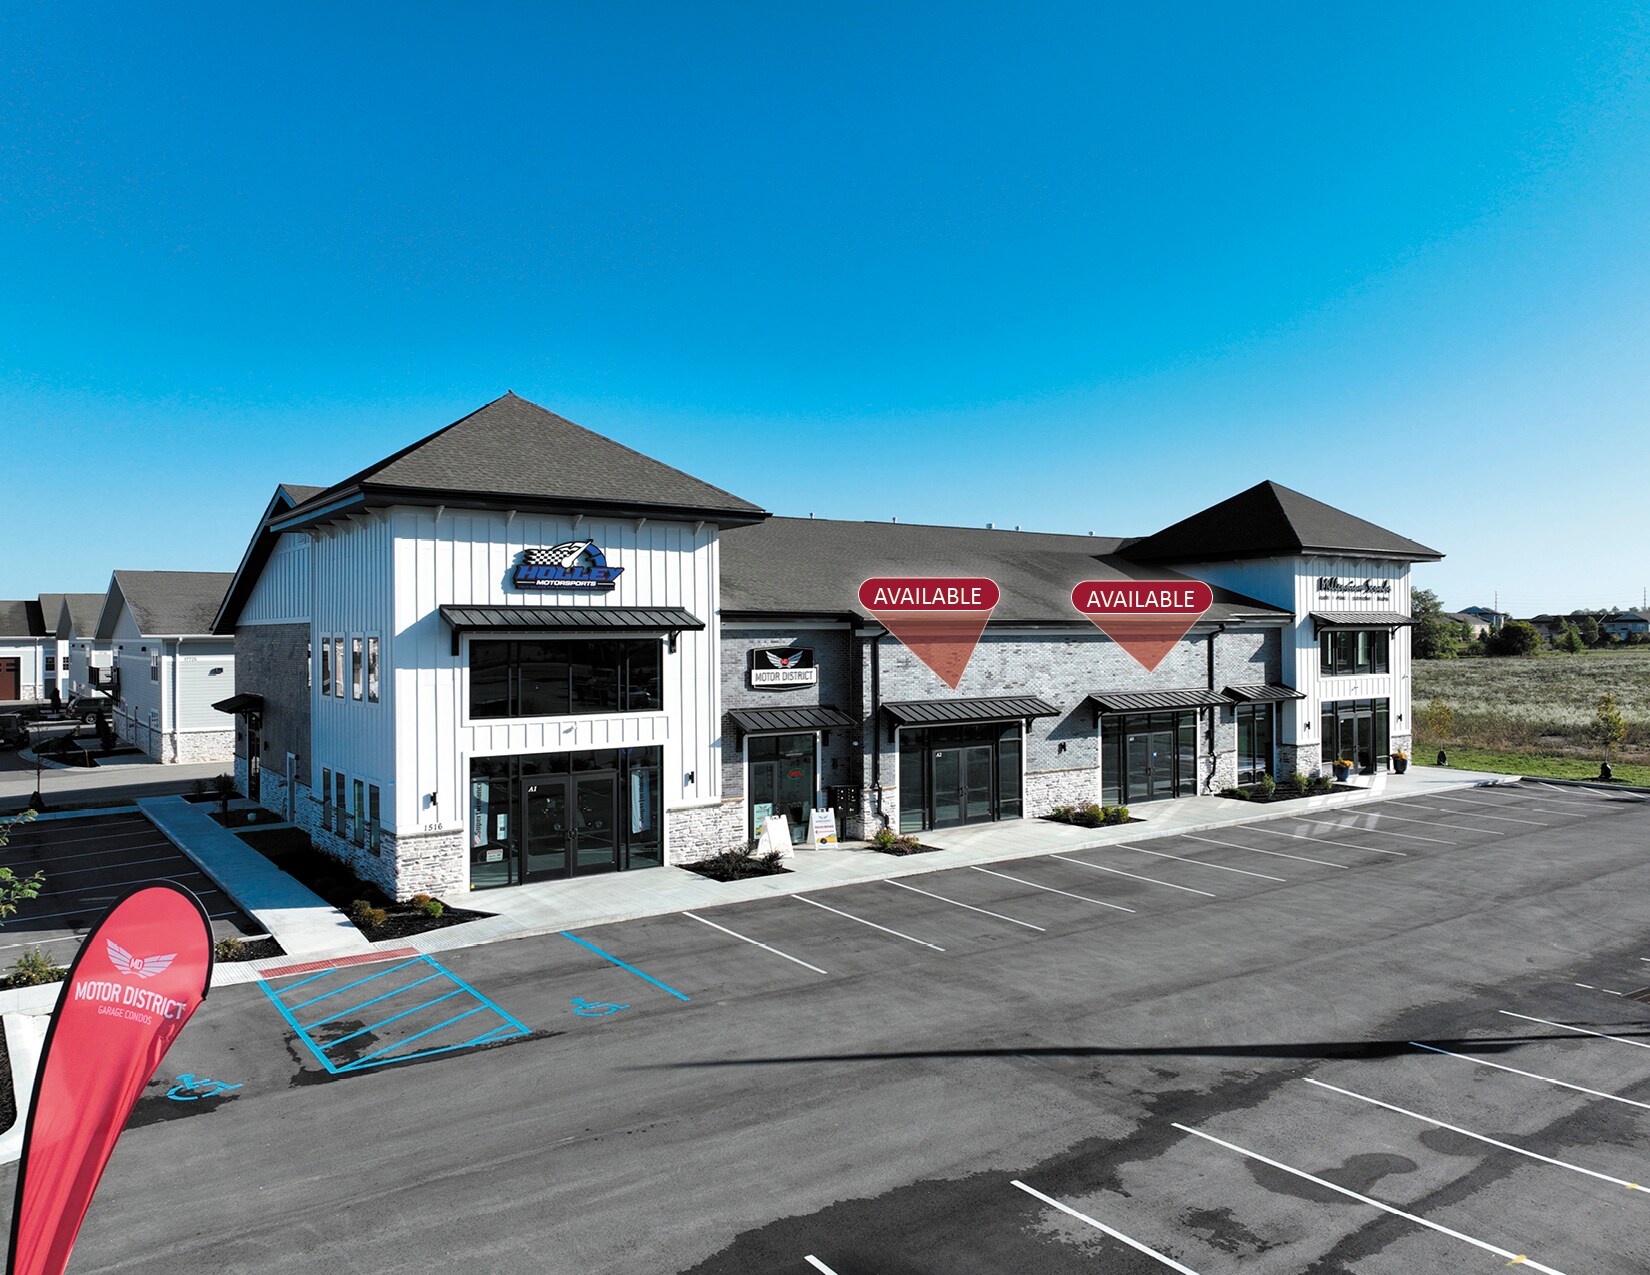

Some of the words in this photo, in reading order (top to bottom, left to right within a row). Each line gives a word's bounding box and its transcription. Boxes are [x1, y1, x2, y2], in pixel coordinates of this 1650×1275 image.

[516, 565, 624, 580] HOLLEY
[755, 672, 780, 682] MOTOR
[782, 670, 813, 681] DISTRICT
[527, 785, 537, 793] A1
[424, 822, 443, 832] 1516
[130, 958, 144, 970] MD
[75, 981, 122, 1002] MOTOR
[123, 985, 187, 1020] DISTRICT
[98, 1005, 124, 1018] GARAGE
[124, 1010, 152, 1025] CONDOS
